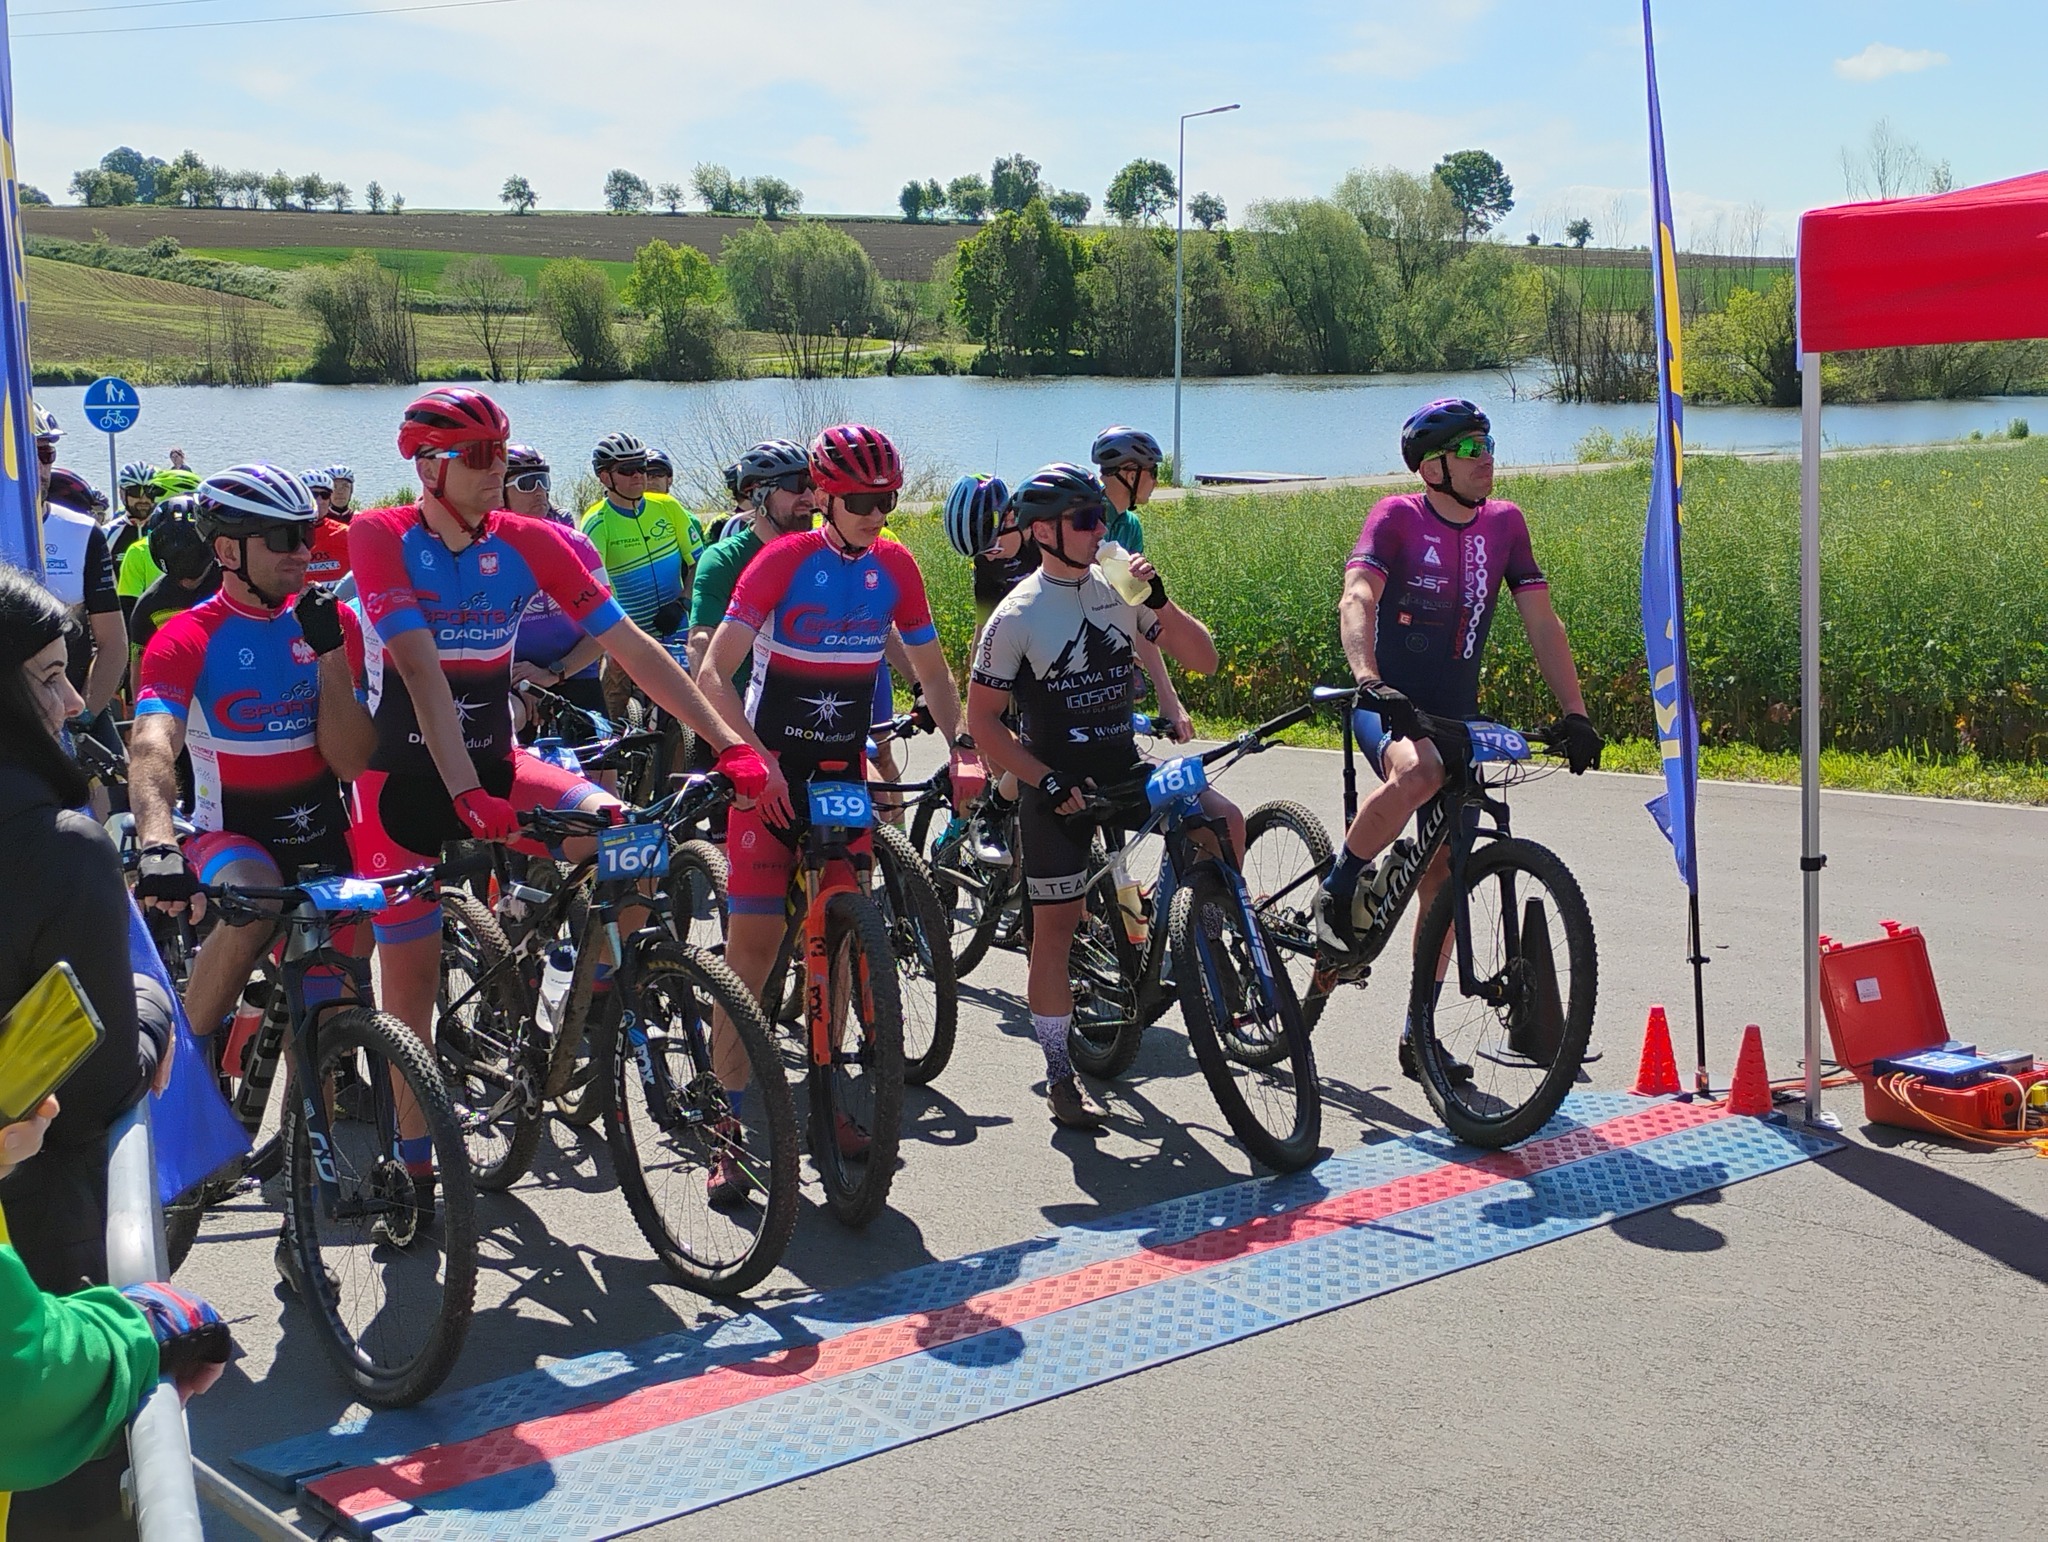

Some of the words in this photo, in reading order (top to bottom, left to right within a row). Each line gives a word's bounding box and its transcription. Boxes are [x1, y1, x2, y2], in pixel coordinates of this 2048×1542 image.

[1047, 671, 1104, 693] MALWA
[1108, 663, 1135, 679] TEAM
[1066, 682, 1128, 709] IGOSPORT
[1475, 732, 1523, 752] 178
[1046, 776, 1062, 796] FOX
[1154, 765, 1195, 795] 181
[816, 795, 865, 817] 139
[605, 844, 661, 872] 160
[1050, 880, 1088, 896] TEA
[809, 985, 823, 1022] FOX
[633, 1043, 656, 1085] FOX
[284, 1111, 297, 1192] RACING
[286, 1197, 299, 1244] RAY
